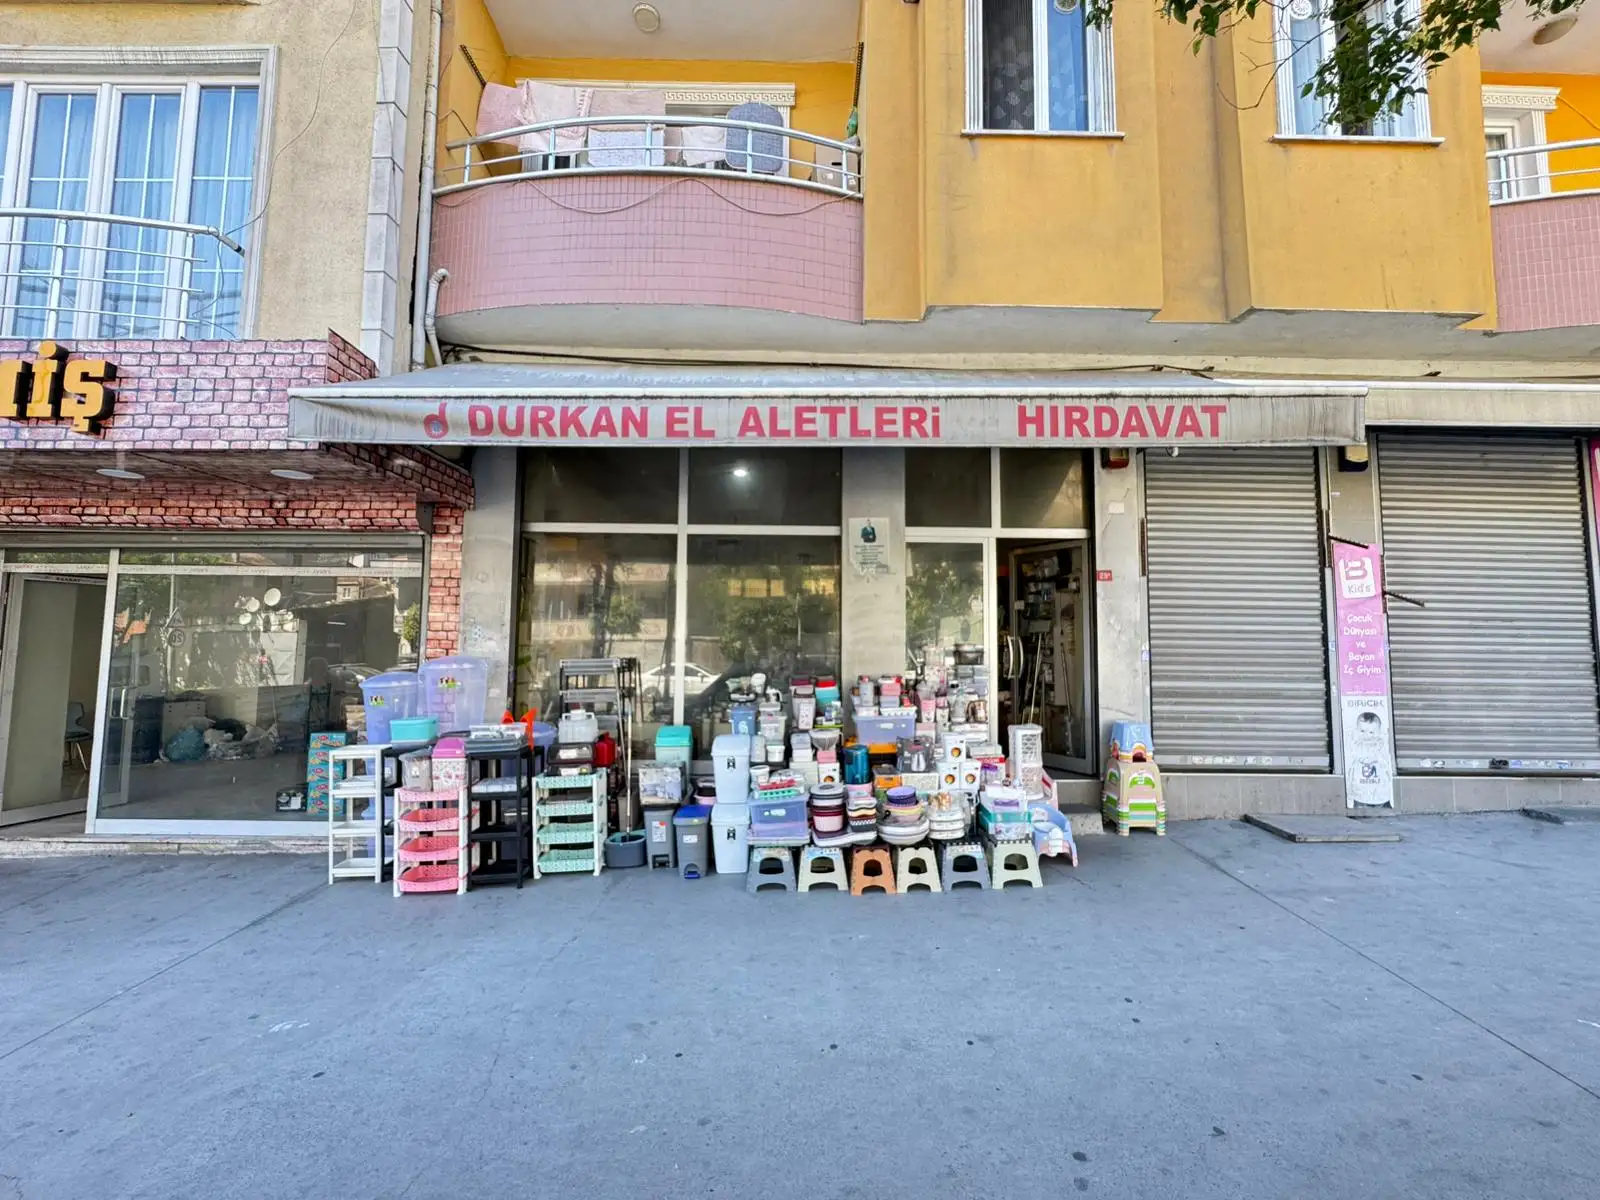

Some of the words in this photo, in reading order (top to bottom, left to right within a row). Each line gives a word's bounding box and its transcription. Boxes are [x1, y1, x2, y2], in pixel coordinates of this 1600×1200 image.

[467, 405, 649, 440] DURKAN
[666, 405, 716, 440] EL
[1018, 403, 1228, 440] HIRDAVAT
[1347, 614, 1373, 625] Çocuk
[1355, 640, 1367, 649] ve
[1348, 652, 1375, 663] Bayan
[1356, 664, 1382, 676] Giyim
